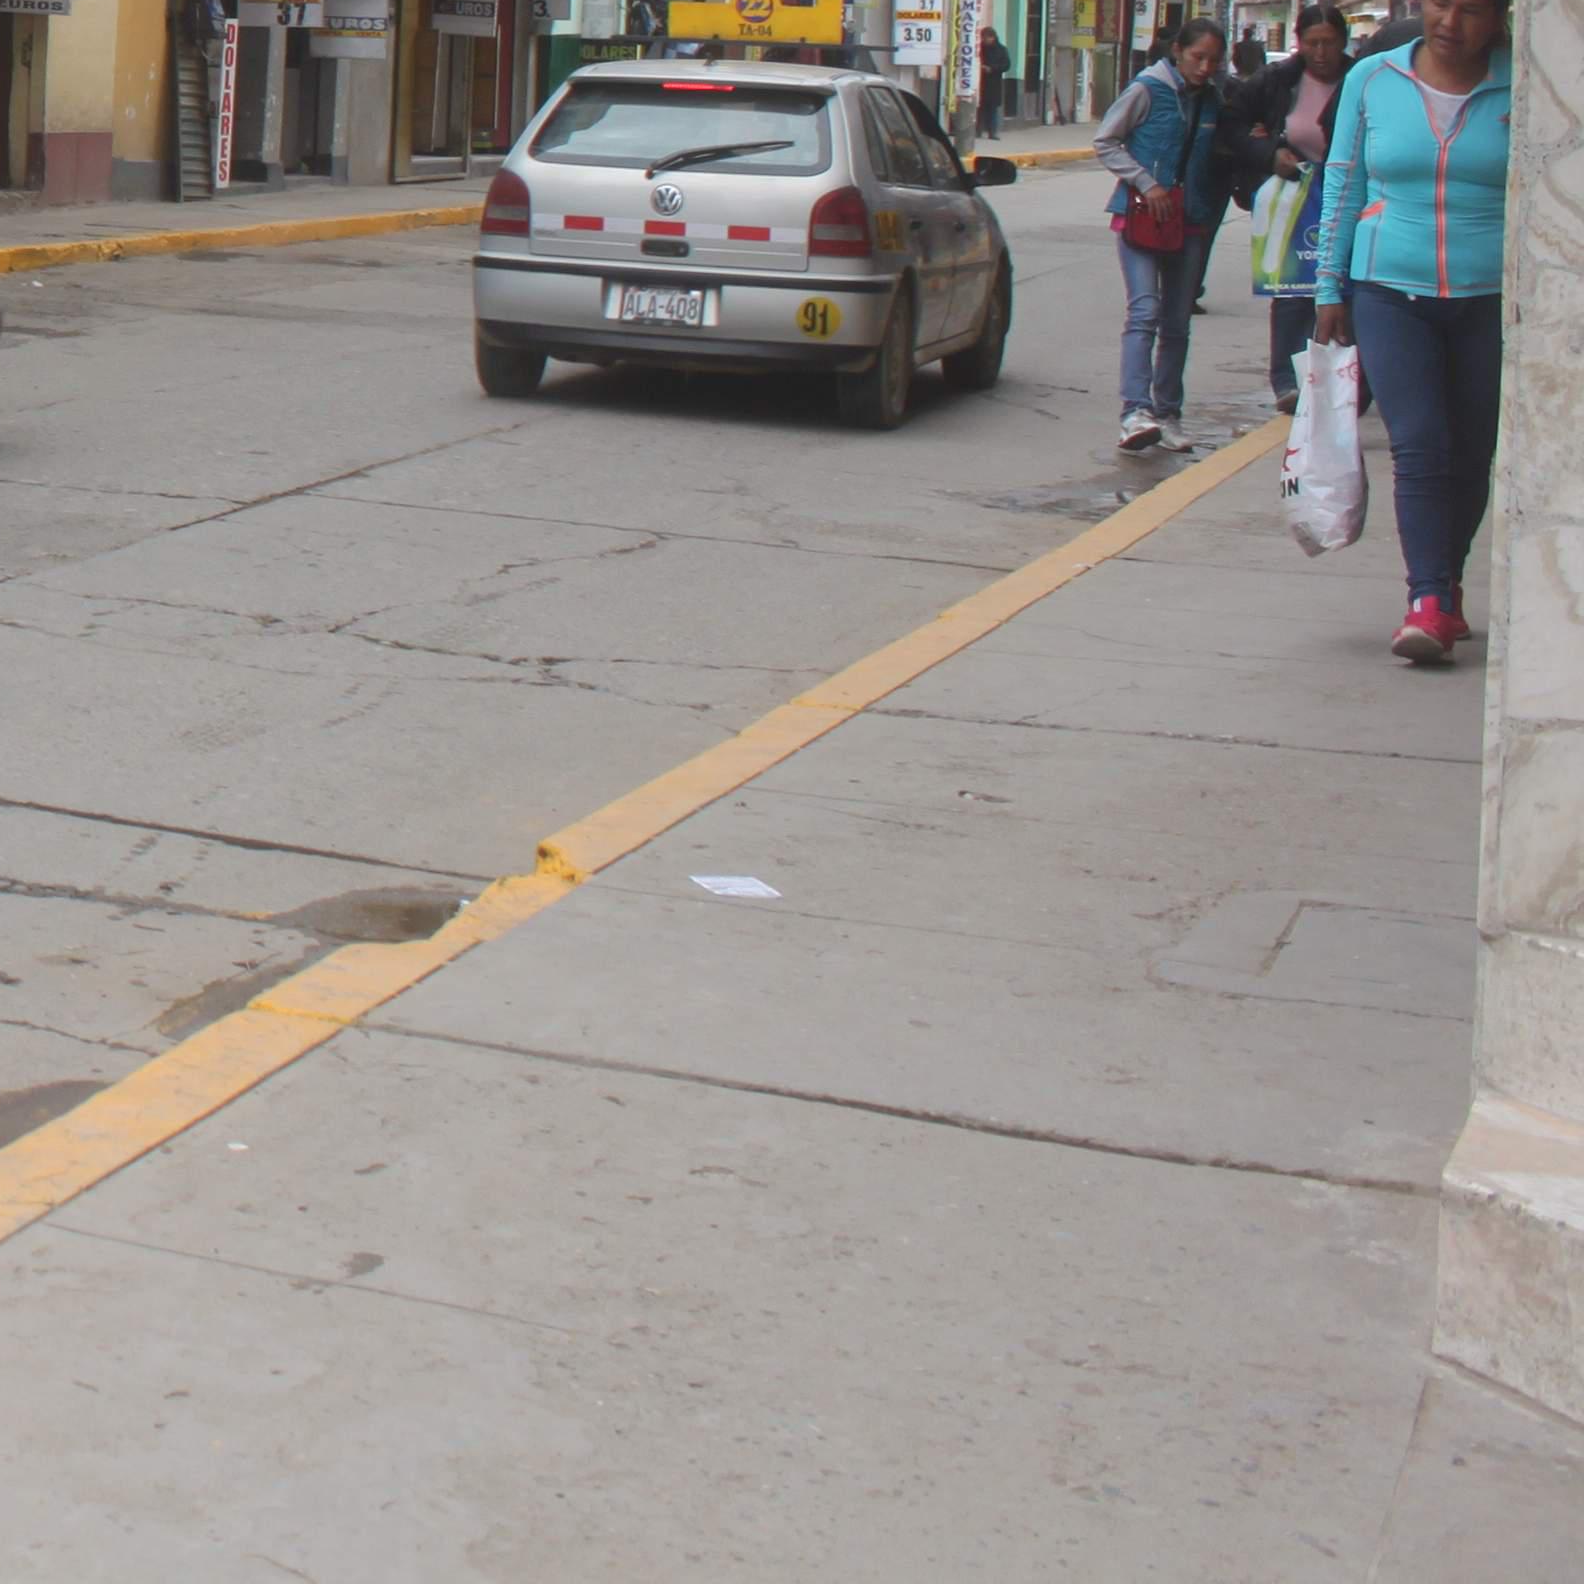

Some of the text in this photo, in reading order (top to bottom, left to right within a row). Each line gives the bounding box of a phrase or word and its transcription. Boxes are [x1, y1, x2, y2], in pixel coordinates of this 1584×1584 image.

[218, 23, 236, 182] DOLARES
[623, 292, 700, 321] ALA-408
[803, 301, 828, 336] 91
